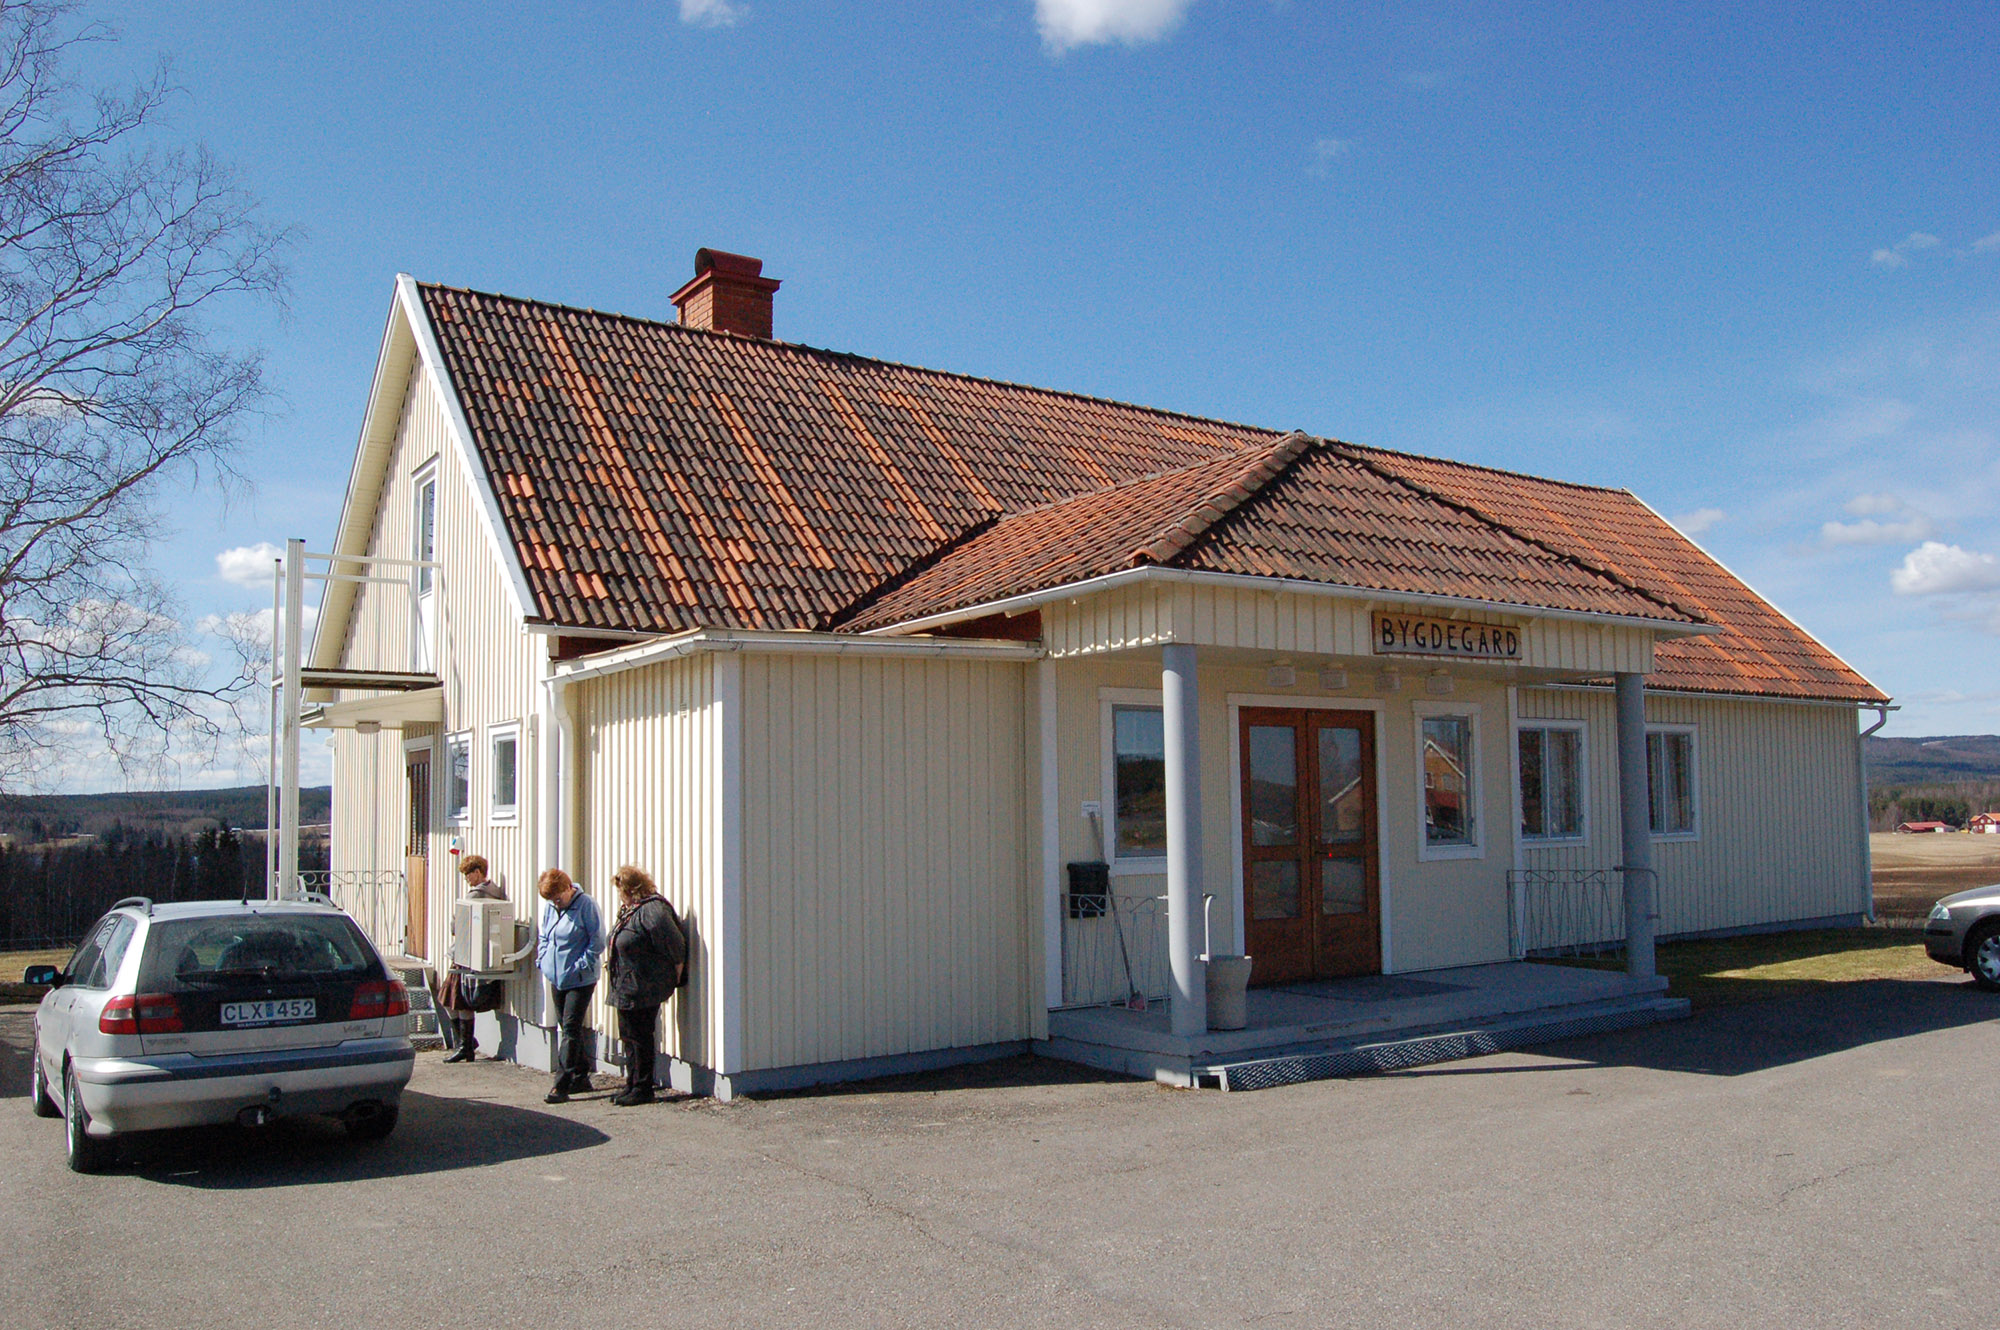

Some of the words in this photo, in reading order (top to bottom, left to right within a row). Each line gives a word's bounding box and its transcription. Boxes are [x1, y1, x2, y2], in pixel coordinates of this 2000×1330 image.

[1381, 618, 1516, 655] BYGDEGÅRD
[224, 1004, 263, 1021] CLX
[277, 1000, 314, 1017] 452
